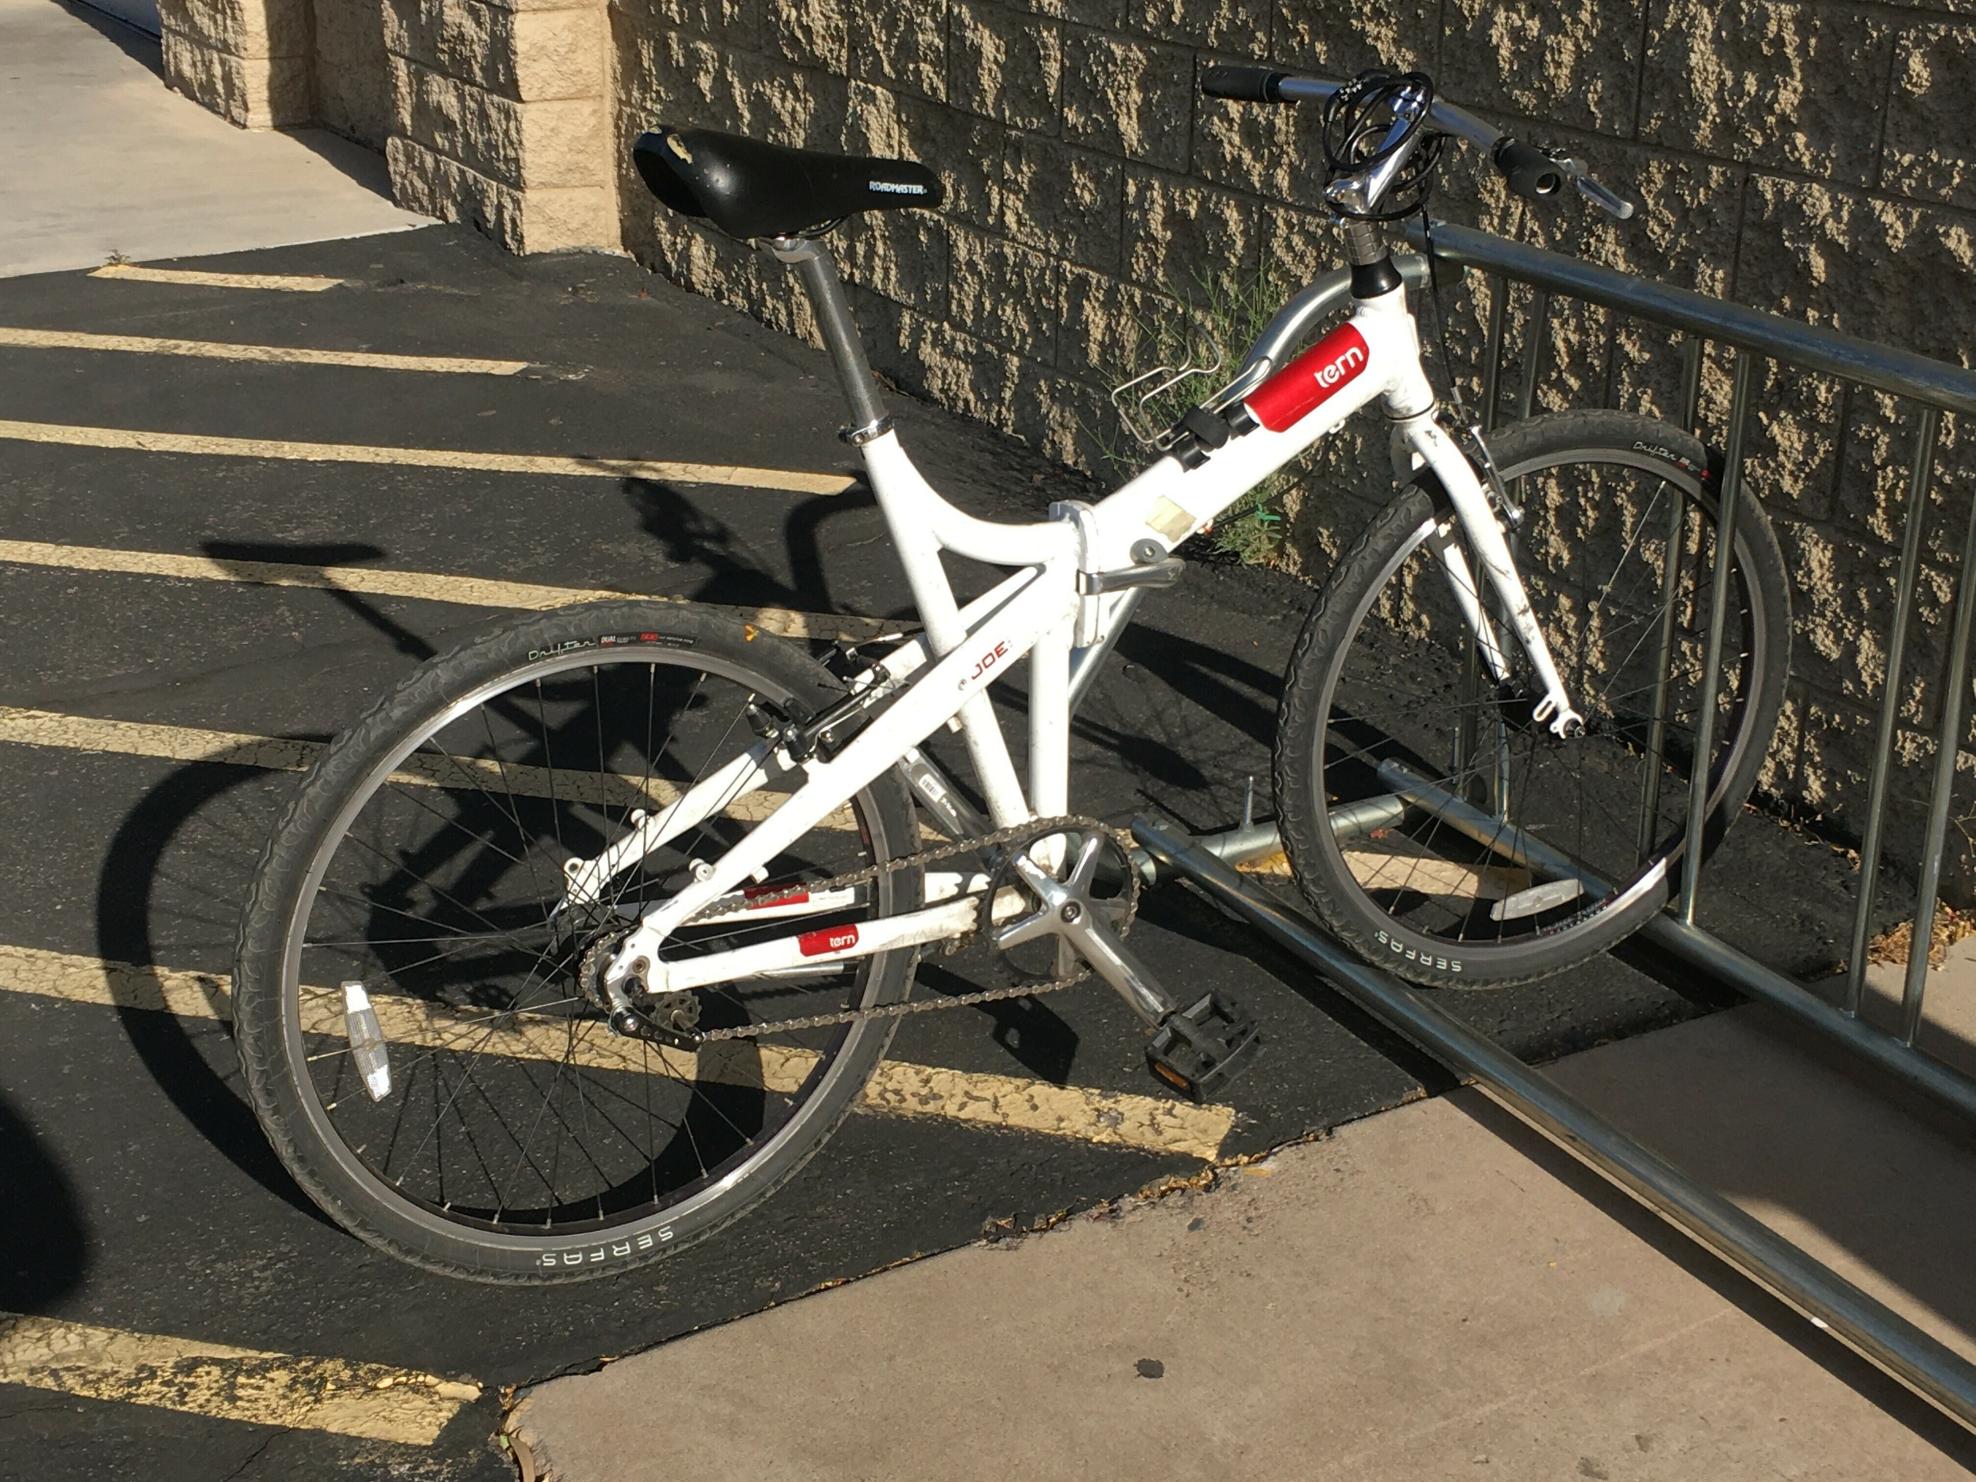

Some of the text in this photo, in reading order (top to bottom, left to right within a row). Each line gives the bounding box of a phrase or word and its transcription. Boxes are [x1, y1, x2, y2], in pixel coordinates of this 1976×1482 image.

[869, 181, 924, 195] ROADMASTER
[1314, 346, 1364, 388] tern
[528, 640, 597, 661] Drifter
[971, 641, 1008, 680] JOE
[829, 934, 856, 948] tern
[1378, 930, 1462, 972] SERFAS
[542, 1225, 674, 1266] SERFAS
